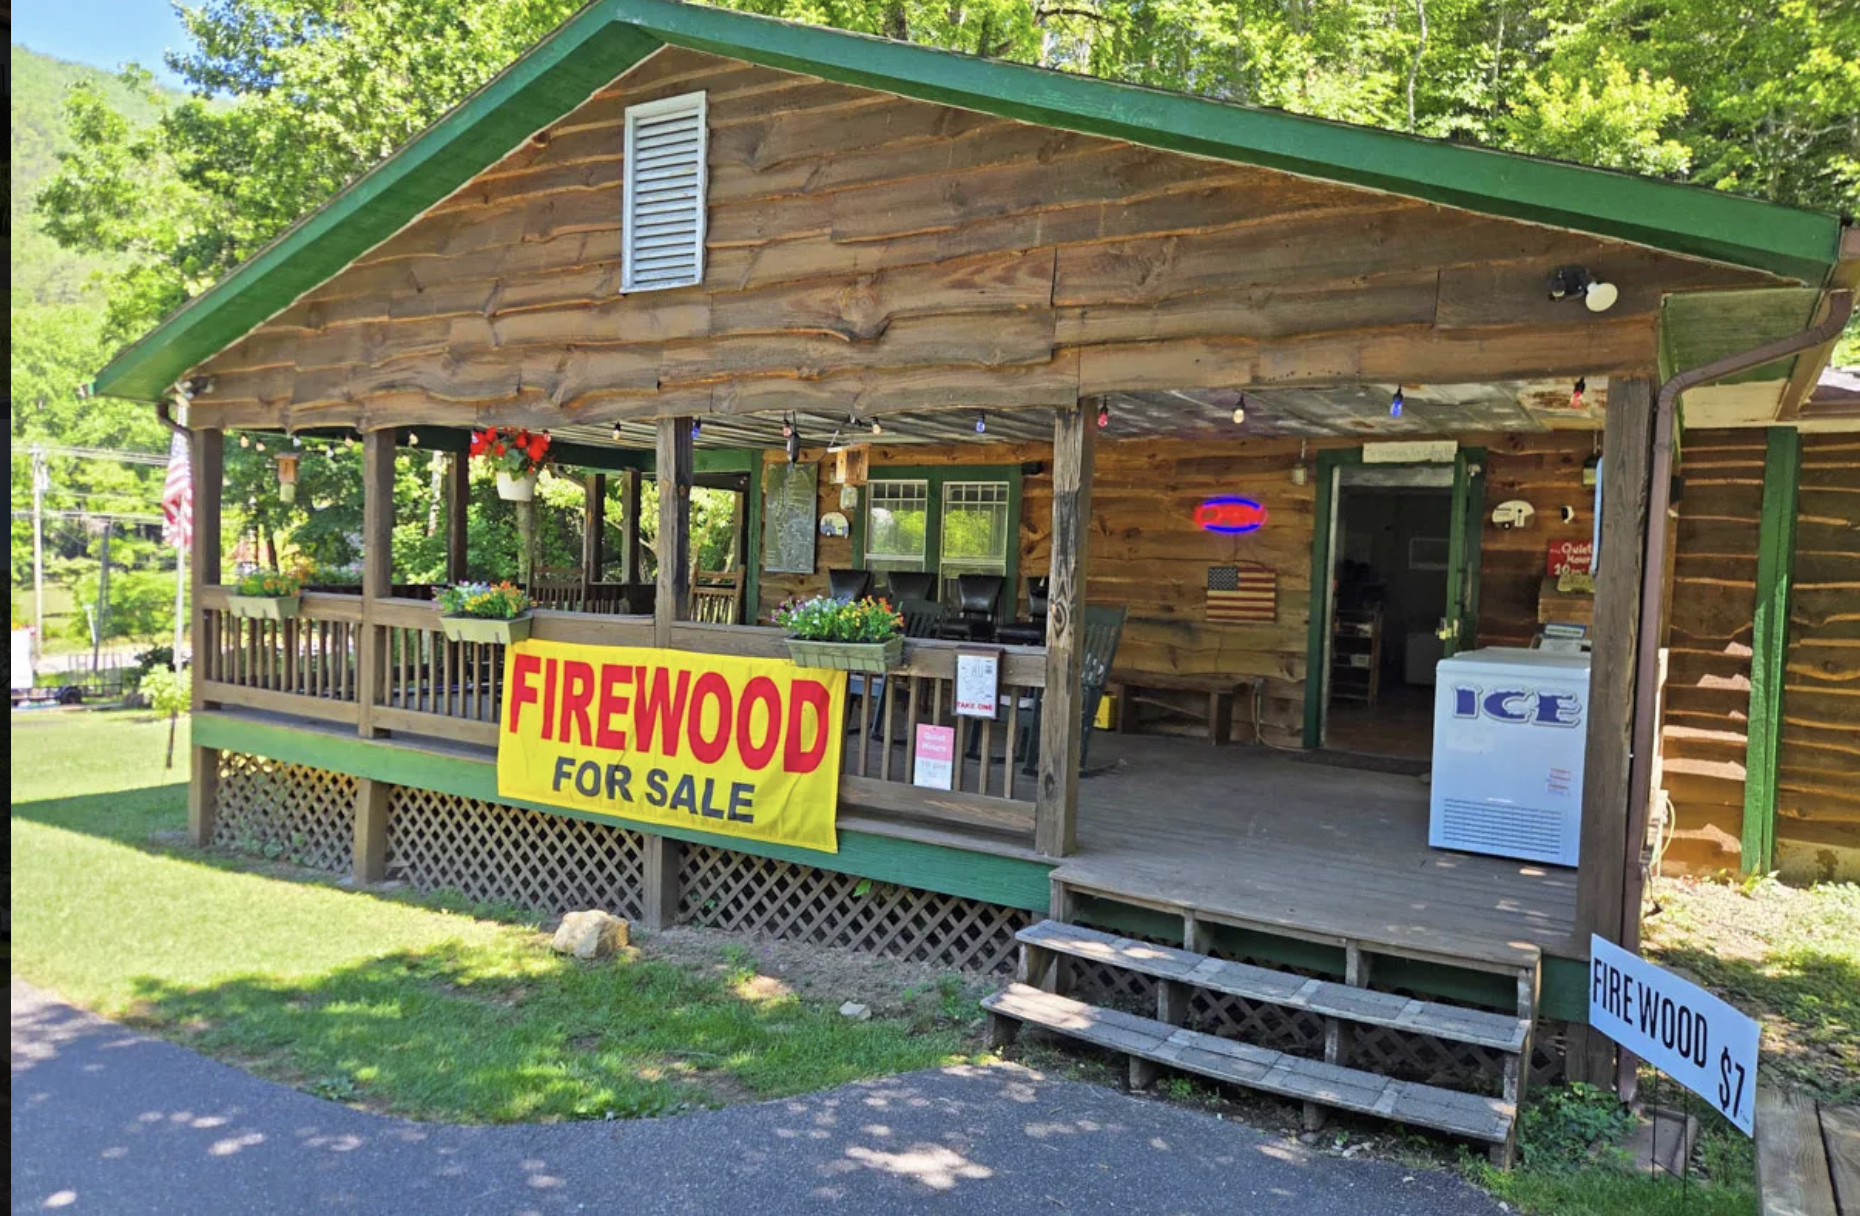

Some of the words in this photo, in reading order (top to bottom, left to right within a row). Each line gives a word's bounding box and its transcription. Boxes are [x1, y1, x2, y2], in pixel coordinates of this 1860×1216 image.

[1561, 542, 1593, 555] Quiet
[1566, 554, 1591, 564] Hour
[1554, 563, 1569, 575] 10
[509, 653, 830, 774] FIREWOOD
[957, 700, 975, 710] TAKE
[977, 702, 993, 712] ONE
[1452, 684, 1582, 728] ICE
[552, 756, 634, 802] FOR
[645, 768, 755, 824] SALE
[1593, 957, 1708, 1069] FIREWOOD
[1718, 1046, 1746, 1118] $7
